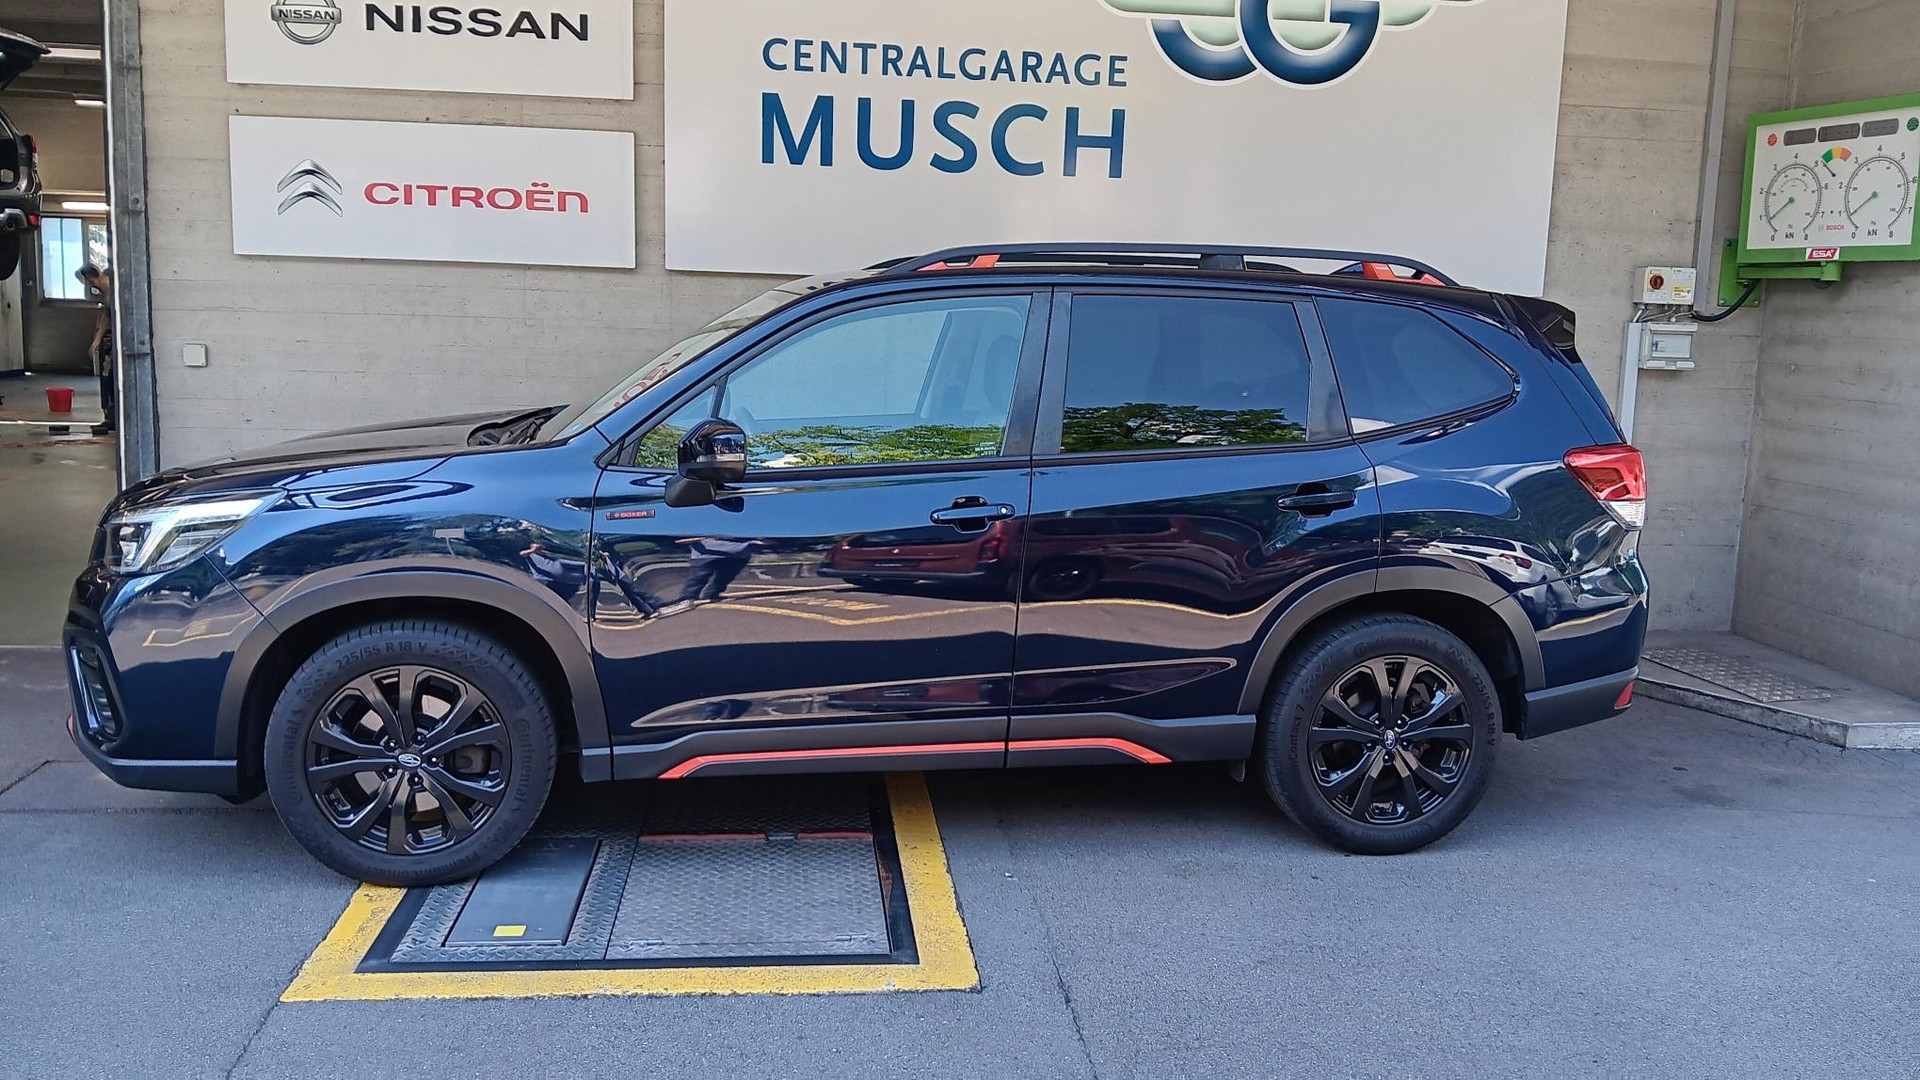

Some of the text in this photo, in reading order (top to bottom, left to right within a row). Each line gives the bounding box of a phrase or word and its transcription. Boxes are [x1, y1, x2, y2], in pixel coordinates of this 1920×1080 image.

[277, 8, 336, 21] NISSAN
[365, 3, 589, 41] NISSAN
[762, 37, 1128, 87] CENTRALGARAGE
[761, 92, 1126, 178] MUSCH
[334, 646, 380, 670] 225/55
[418, 642, 428, 653] V
[1472, 672, 1493, 710] 225/55
